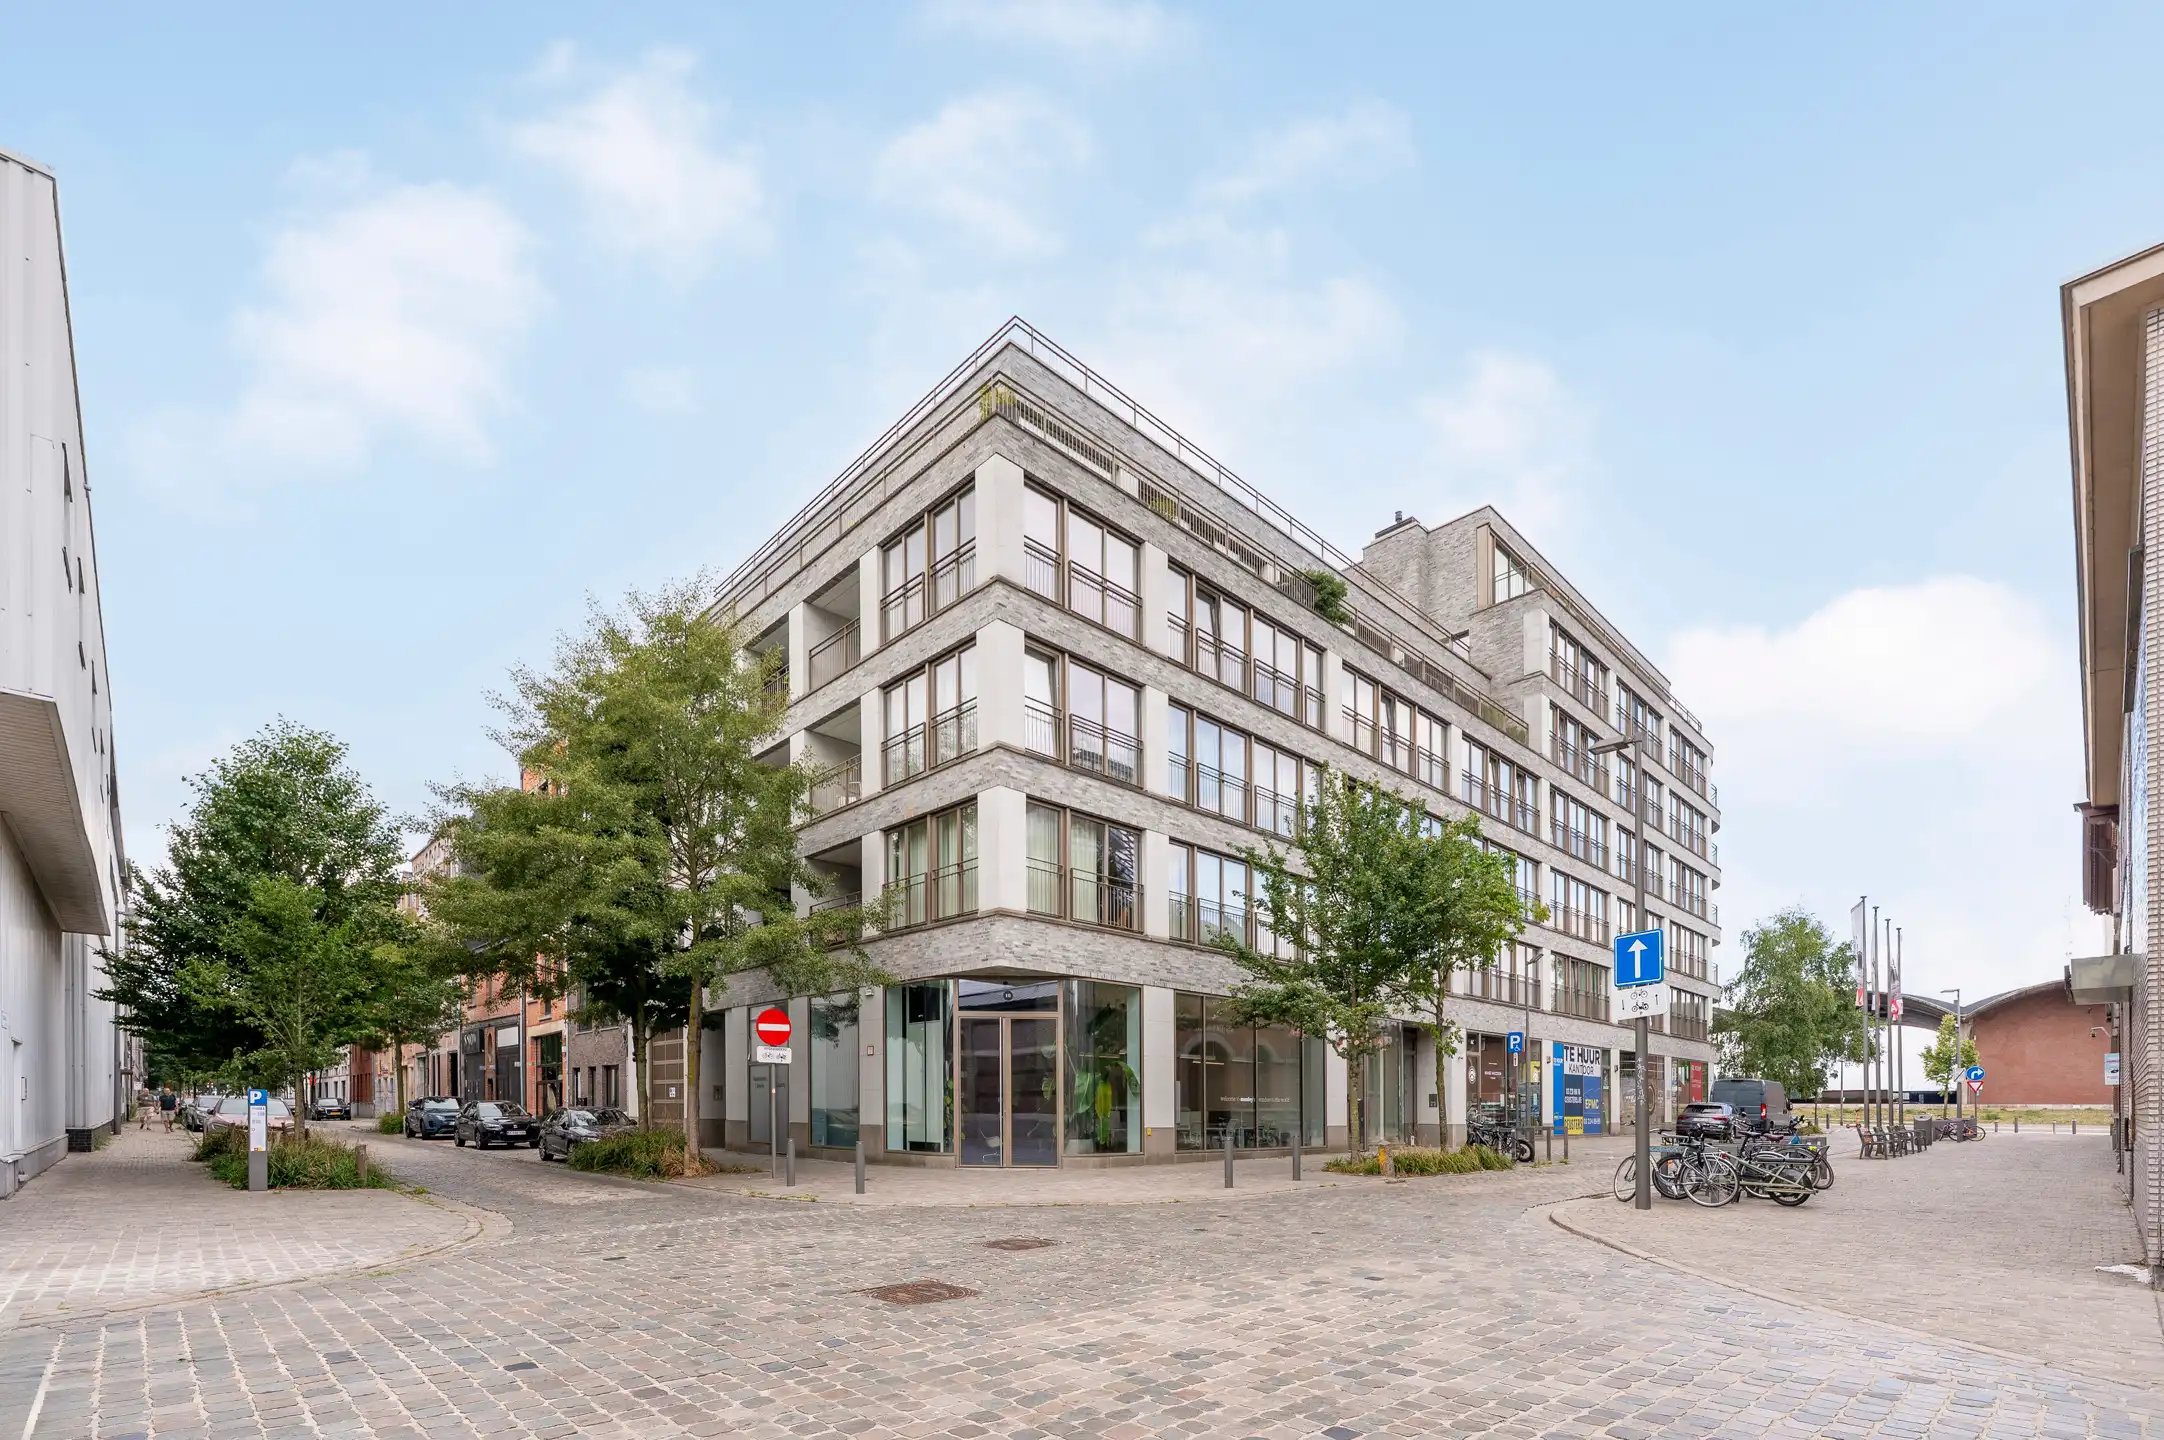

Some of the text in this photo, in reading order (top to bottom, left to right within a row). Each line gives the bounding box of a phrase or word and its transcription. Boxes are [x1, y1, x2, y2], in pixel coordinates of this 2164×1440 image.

[1510, 1035, 1521, 1049] P
[1564, 1045, 1601, 1065] TE HUUR
[1568, 1063, 1594, 1075] KANTOOR
[250, 1090, 262, 1104] P
